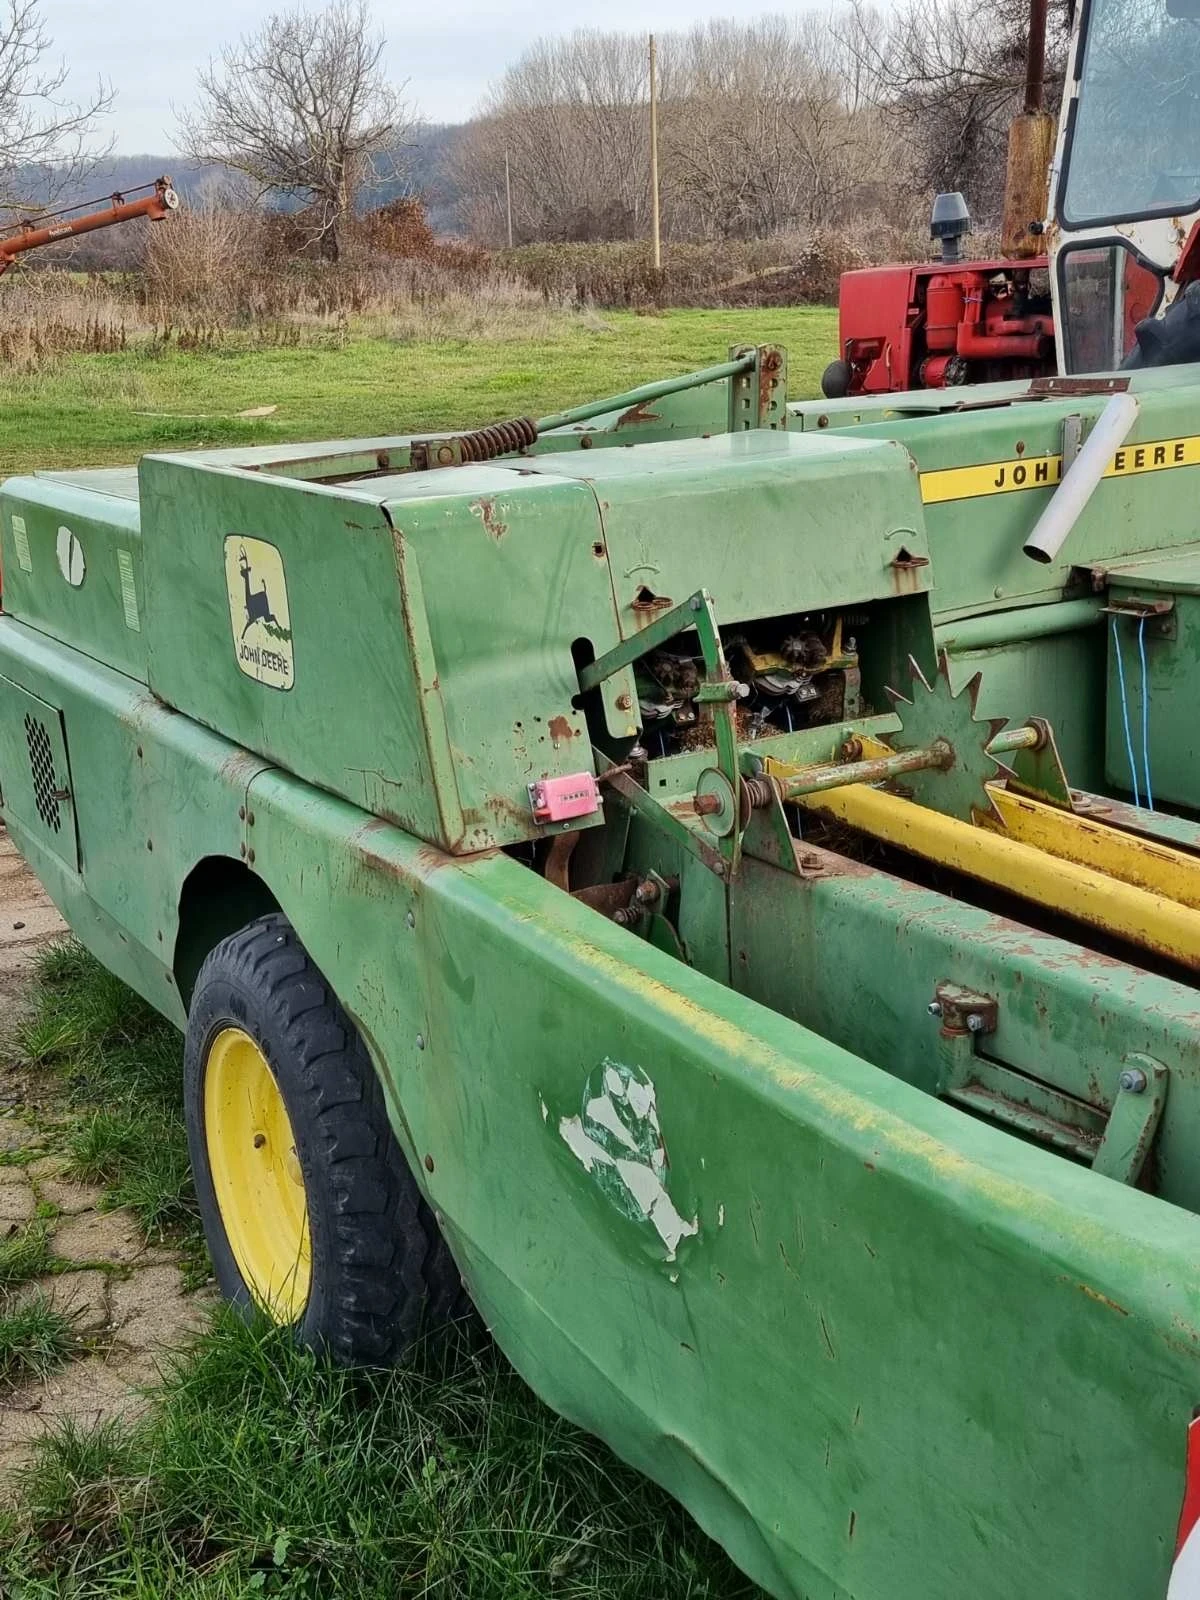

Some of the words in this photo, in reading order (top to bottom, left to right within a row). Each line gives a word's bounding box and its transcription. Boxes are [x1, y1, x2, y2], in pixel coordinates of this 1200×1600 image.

[1114, 443, 1185, 471] EERE
[239, 643, 261, 665] JOHN
[261, 648, 289, 676] DEERE
